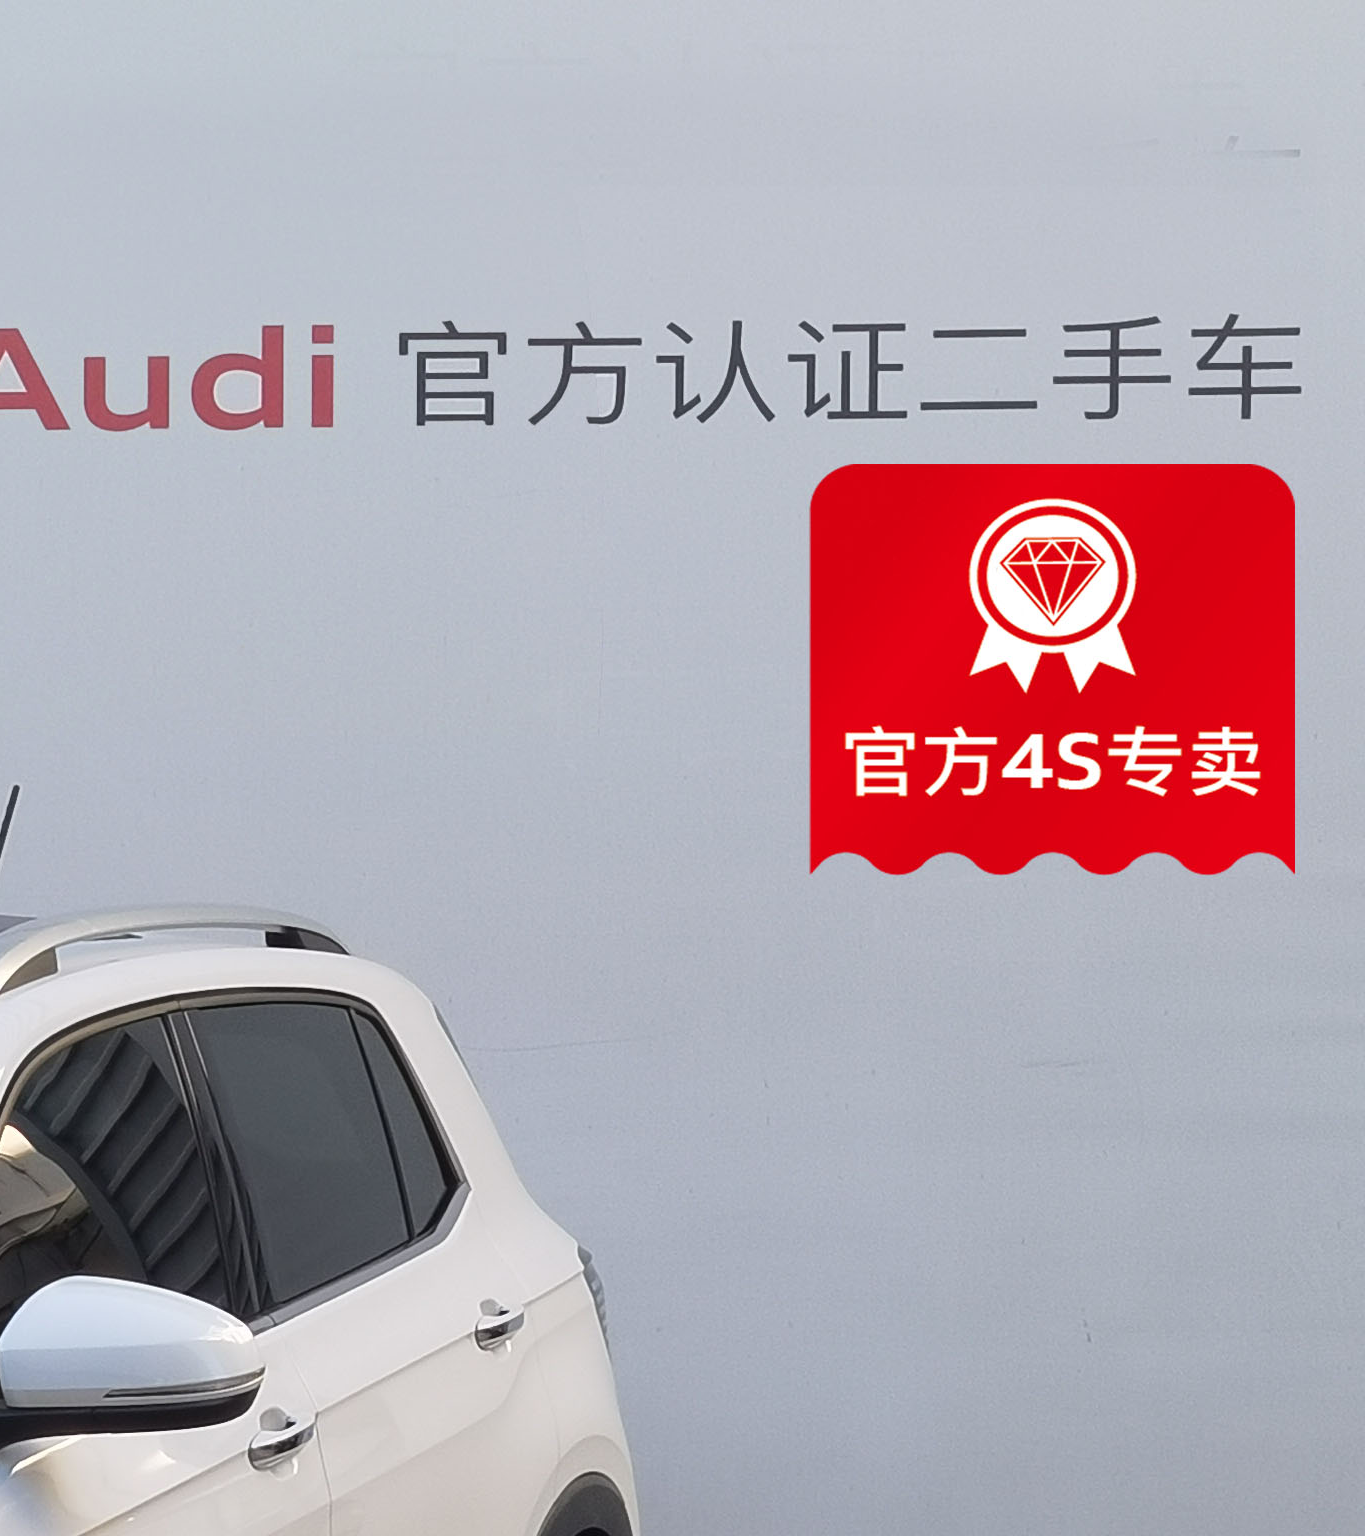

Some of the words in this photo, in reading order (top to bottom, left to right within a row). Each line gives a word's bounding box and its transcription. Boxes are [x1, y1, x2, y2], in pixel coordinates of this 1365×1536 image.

[399, 314, 1302, 426] 官方认证二手车
